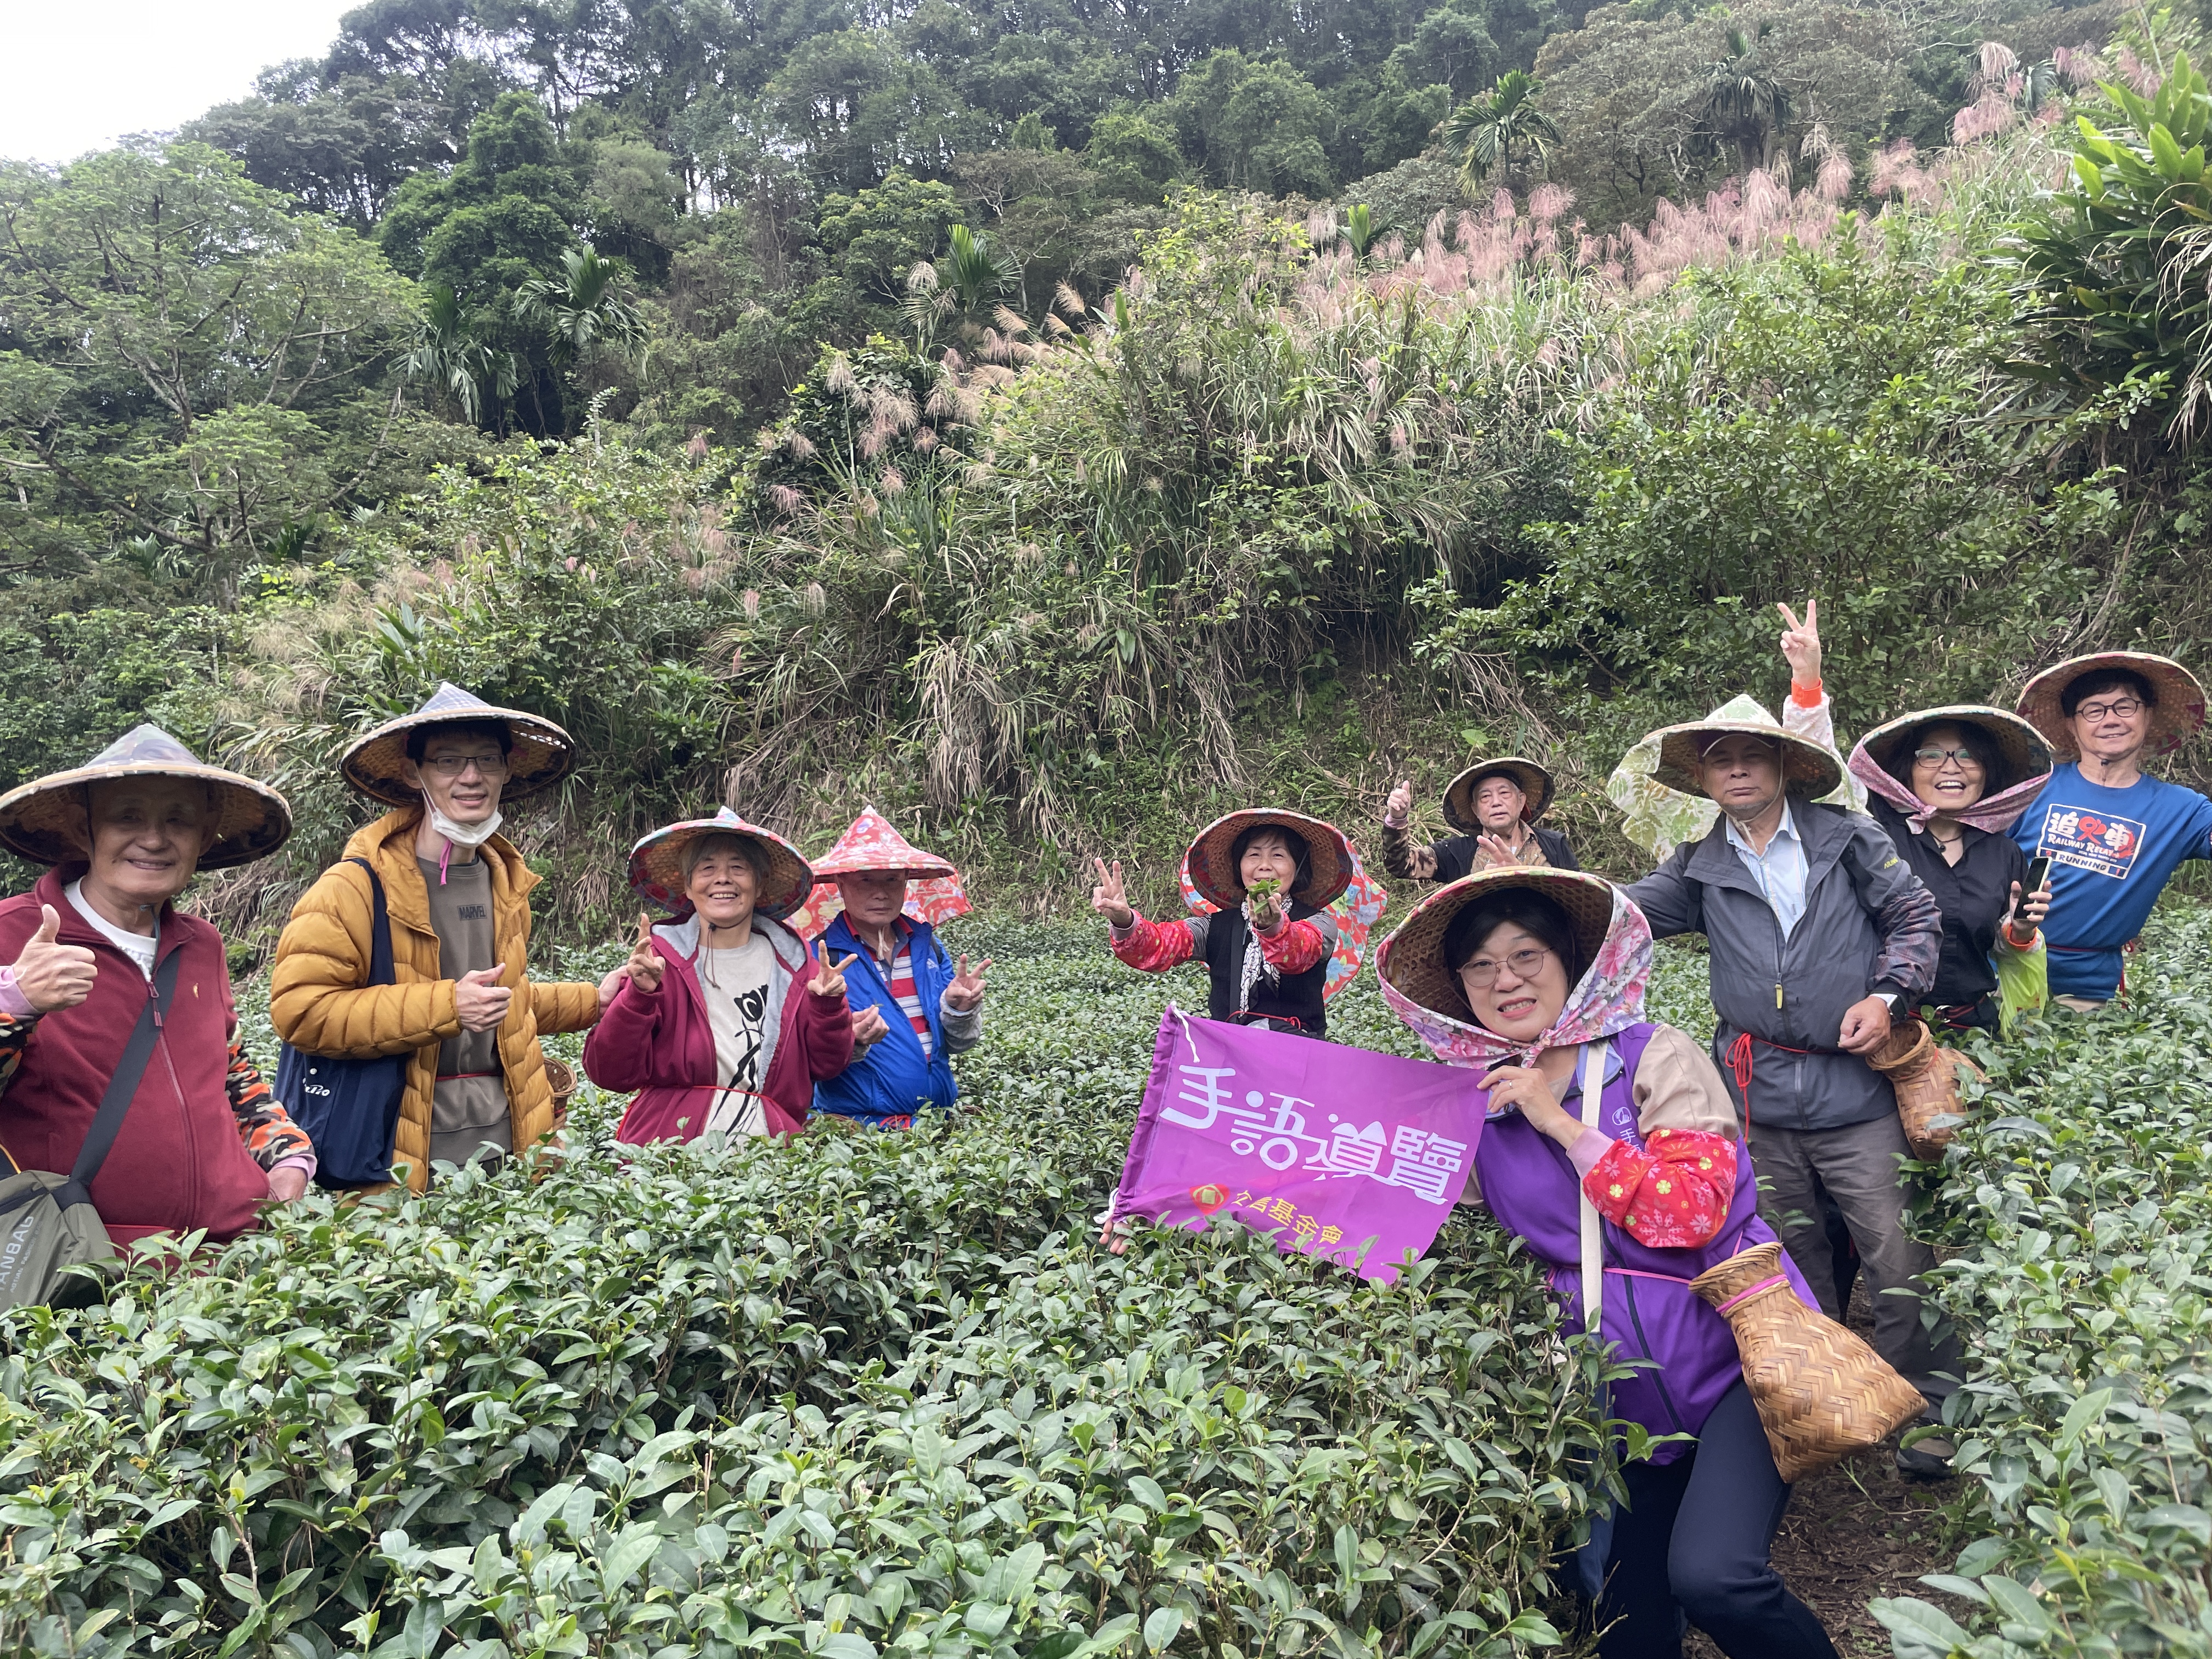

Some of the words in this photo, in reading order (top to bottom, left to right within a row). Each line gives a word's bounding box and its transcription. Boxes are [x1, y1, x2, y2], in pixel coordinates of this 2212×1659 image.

[2047, 833, 2085, 850] RAILWAY
[2058, 854, 2107, 871] RUNNING
[459, 905, 486, 919] MARVEL
[1159, 1064, 1468, 1205] 手語導覽
